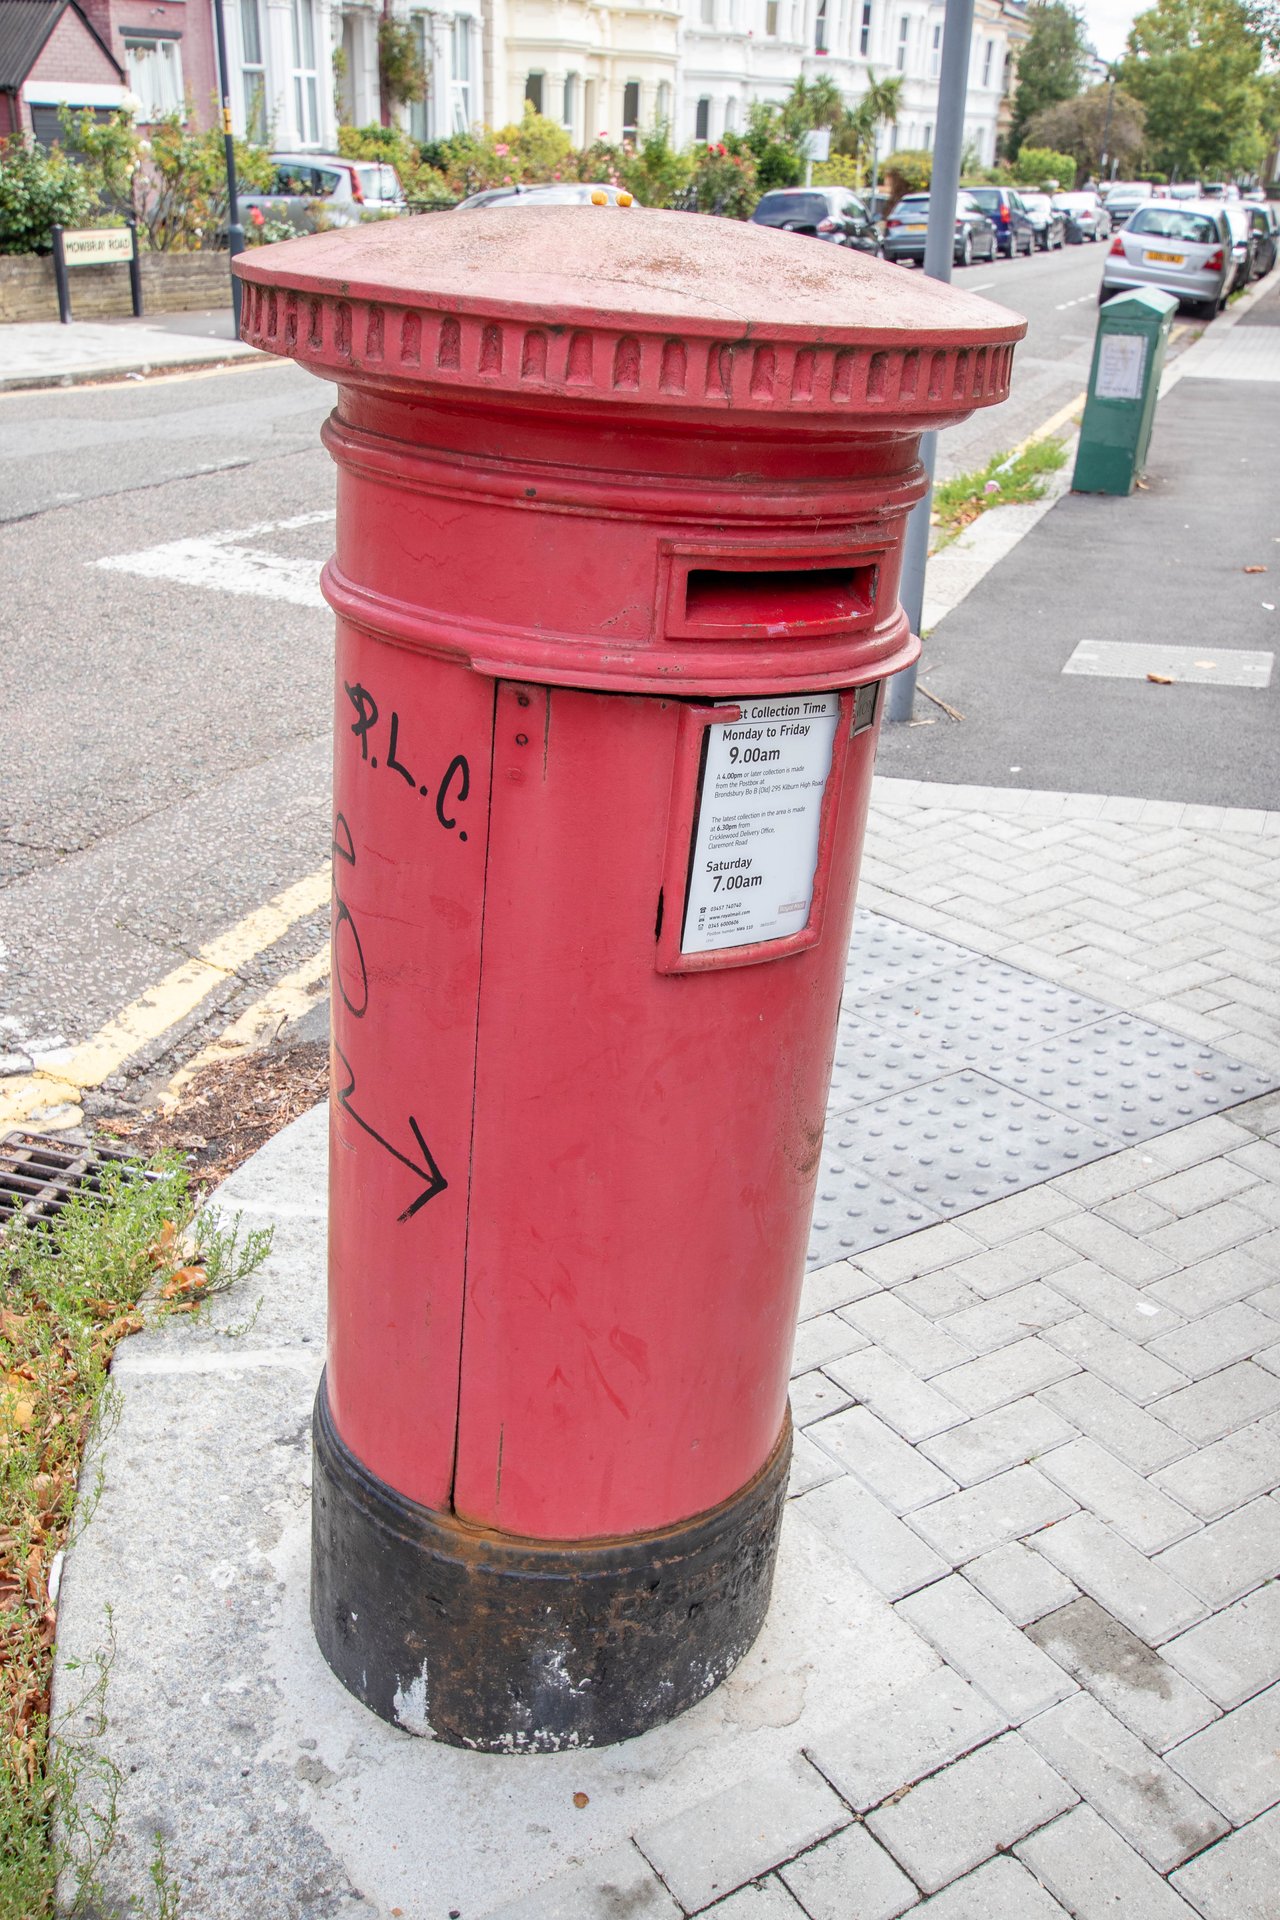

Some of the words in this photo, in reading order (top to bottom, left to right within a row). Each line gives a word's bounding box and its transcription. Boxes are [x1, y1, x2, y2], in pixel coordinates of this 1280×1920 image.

[66, 240, 105, 253] MOWBRAY
[109, 238, 130, 249] ROAD
[752, 706, 800, 719] Collection
[803, 703, 827, 714] Time
[722, 728, 764, 742] Monday
[767, 728, 777, 738] to
[780, 725, 811, 736] Friday
[730, 746, 780, 765] 9.00am
[763, 768, 785, 776] collection
[715, 790, 744, 798] Brondsbury
[771, 785, 782, 793] 295
[737, 812, 760, 820] collection
[709, 832, 739, 841] Cricklewood
[740, 829, 760, 838] Delivery
[708, 841, 734, 850] Claremont
[706, 858, 753, 873] Saturday
[713, 875, 763, 893] 7.00am
[709, 910, 751, 920] www.royalmail.com
